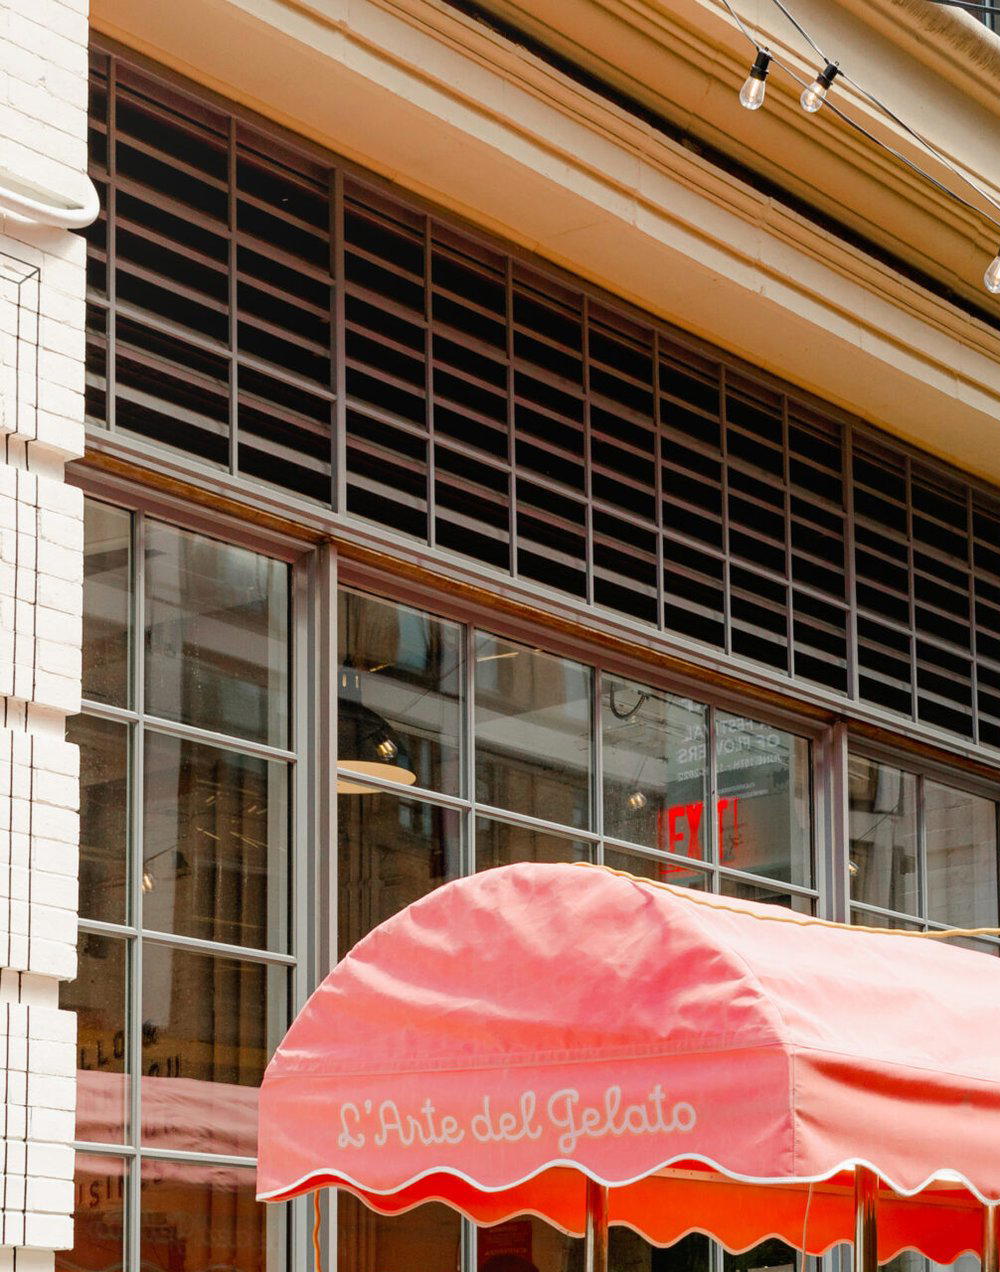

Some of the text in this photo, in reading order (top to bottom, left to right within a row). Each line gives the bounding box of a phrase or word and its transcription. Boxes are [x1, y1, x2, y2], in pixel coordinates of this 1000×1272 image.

[338, 1085, 697, 1154] L'Arte del Gelato
